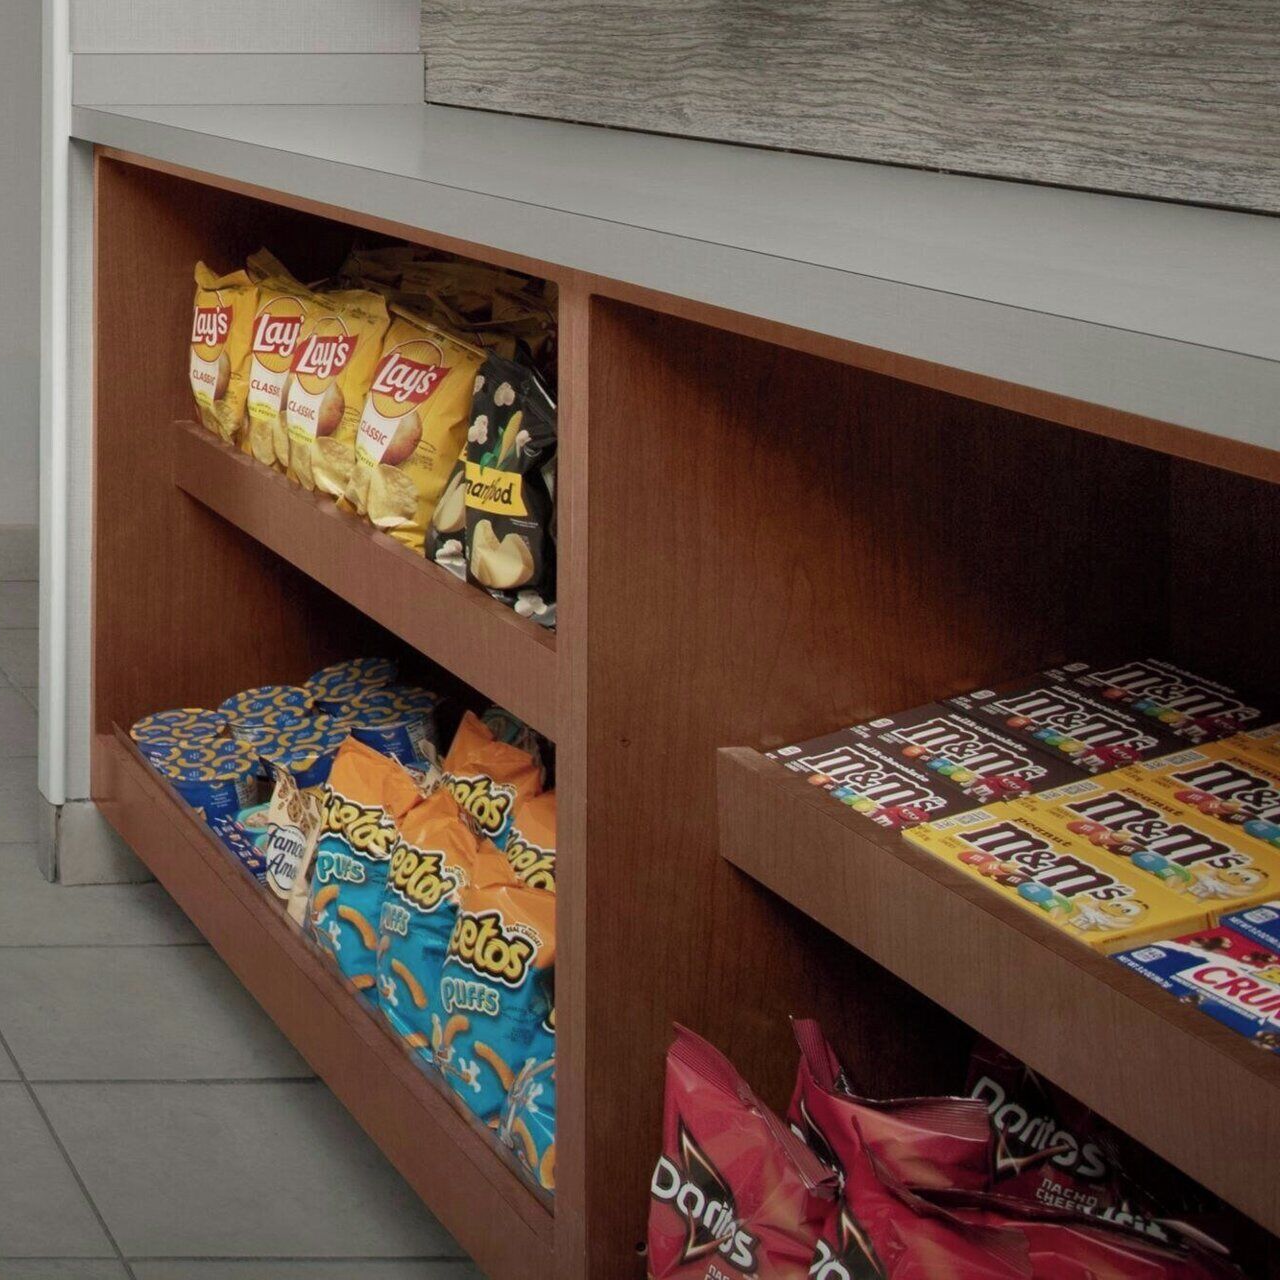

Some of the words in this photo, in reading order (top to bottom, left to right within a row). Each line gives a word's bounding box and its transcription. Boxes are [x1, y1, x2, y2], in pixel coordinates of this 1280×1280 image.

[191, 306, 228, 347] Lay's
[295, 334, 350, 379] Lay's
[371, 352, 437, 403] Lay's
[288, 400, 316, 420] CLASSIC
[359, 419, 388, 446] CLASSIC
[993, 688, 1159, 751] m&m's
[889, 717, 1048, 782] m&m's
[797, 746, 948, 813] m&m's
[1122, 786, 1184, 817] peanut
[1016, 815, 1073, 848] peanut
[1062, 791, 1254, 870] m&m's
[955, 821, 1137, 901] m&m's
[650, 1155, 754, 1268] Doritos
[1041, 1178, 1098, 1209] NACHO
